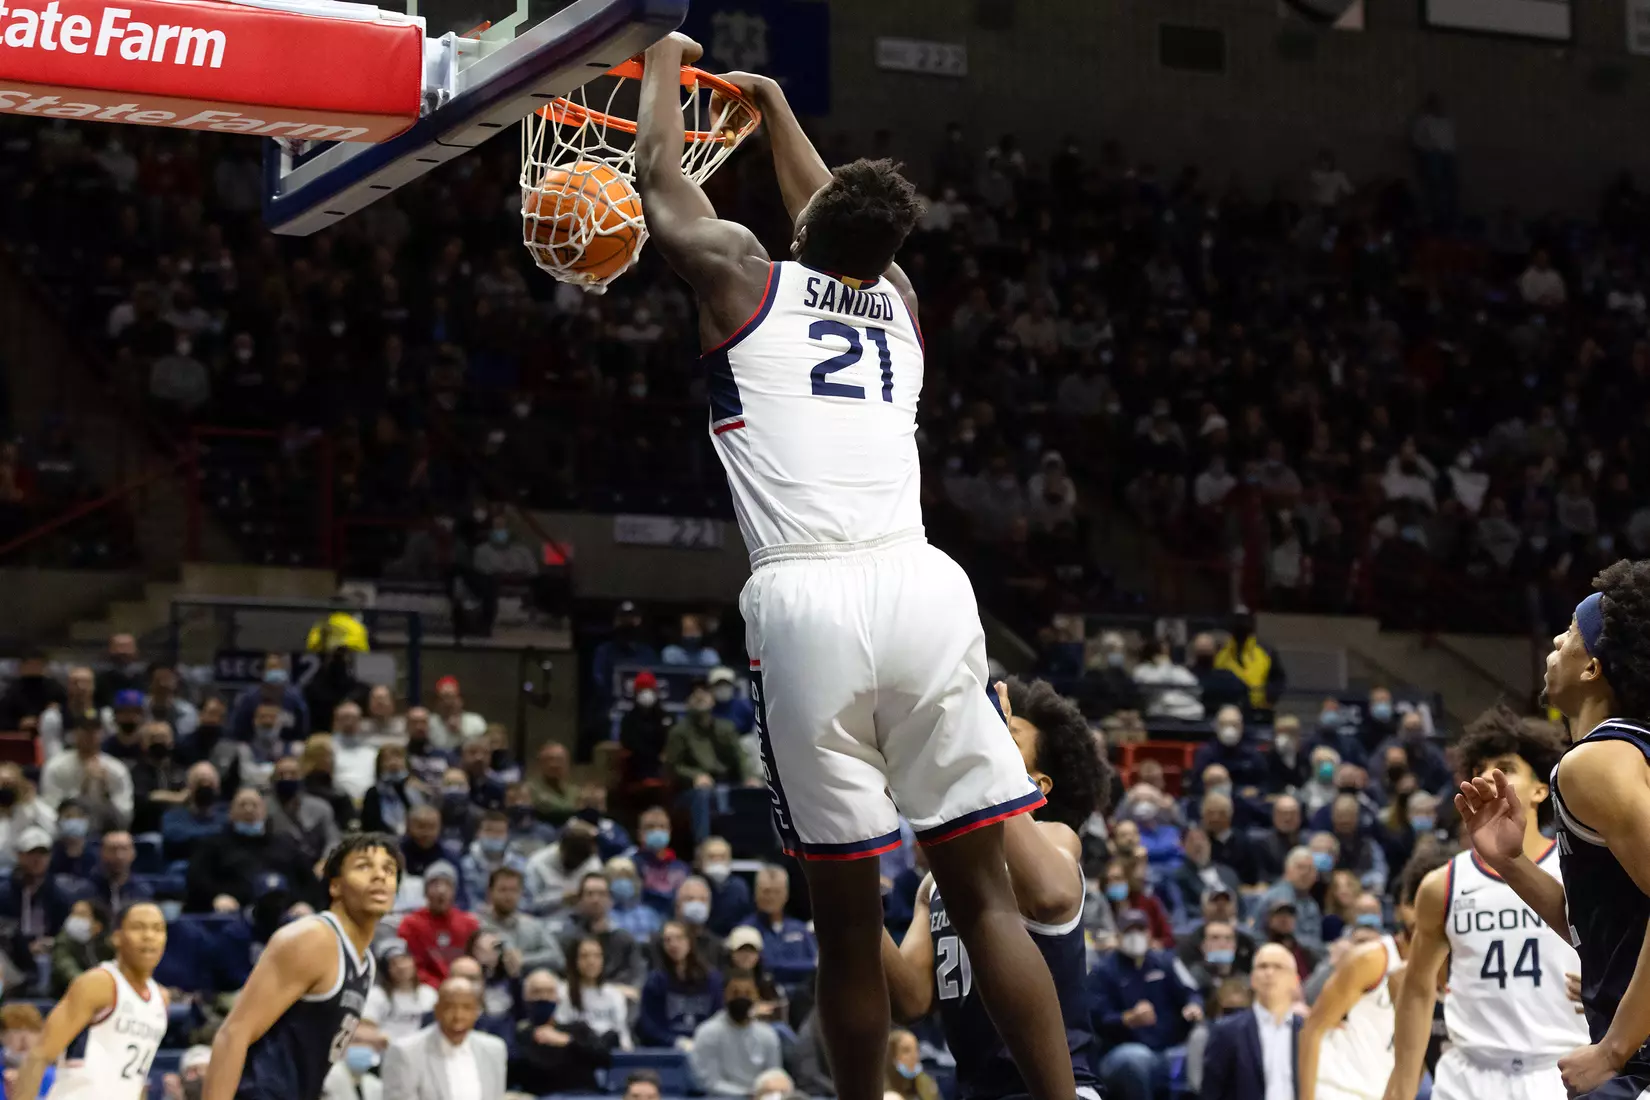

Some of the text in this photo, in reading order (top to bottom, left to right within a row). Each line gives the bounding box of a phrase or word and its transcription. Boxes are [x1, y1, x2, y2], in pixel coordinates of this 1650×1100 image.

[94, 7, 227, 69] Farm
[0, 90, 370, 140] State Farm
[803, 276, 894, 321] SANOGO
[808, 319, 894, 403] 21
[1454, 908, 1550, 935] UCON
[1480, 937, 1543, 990] 44
